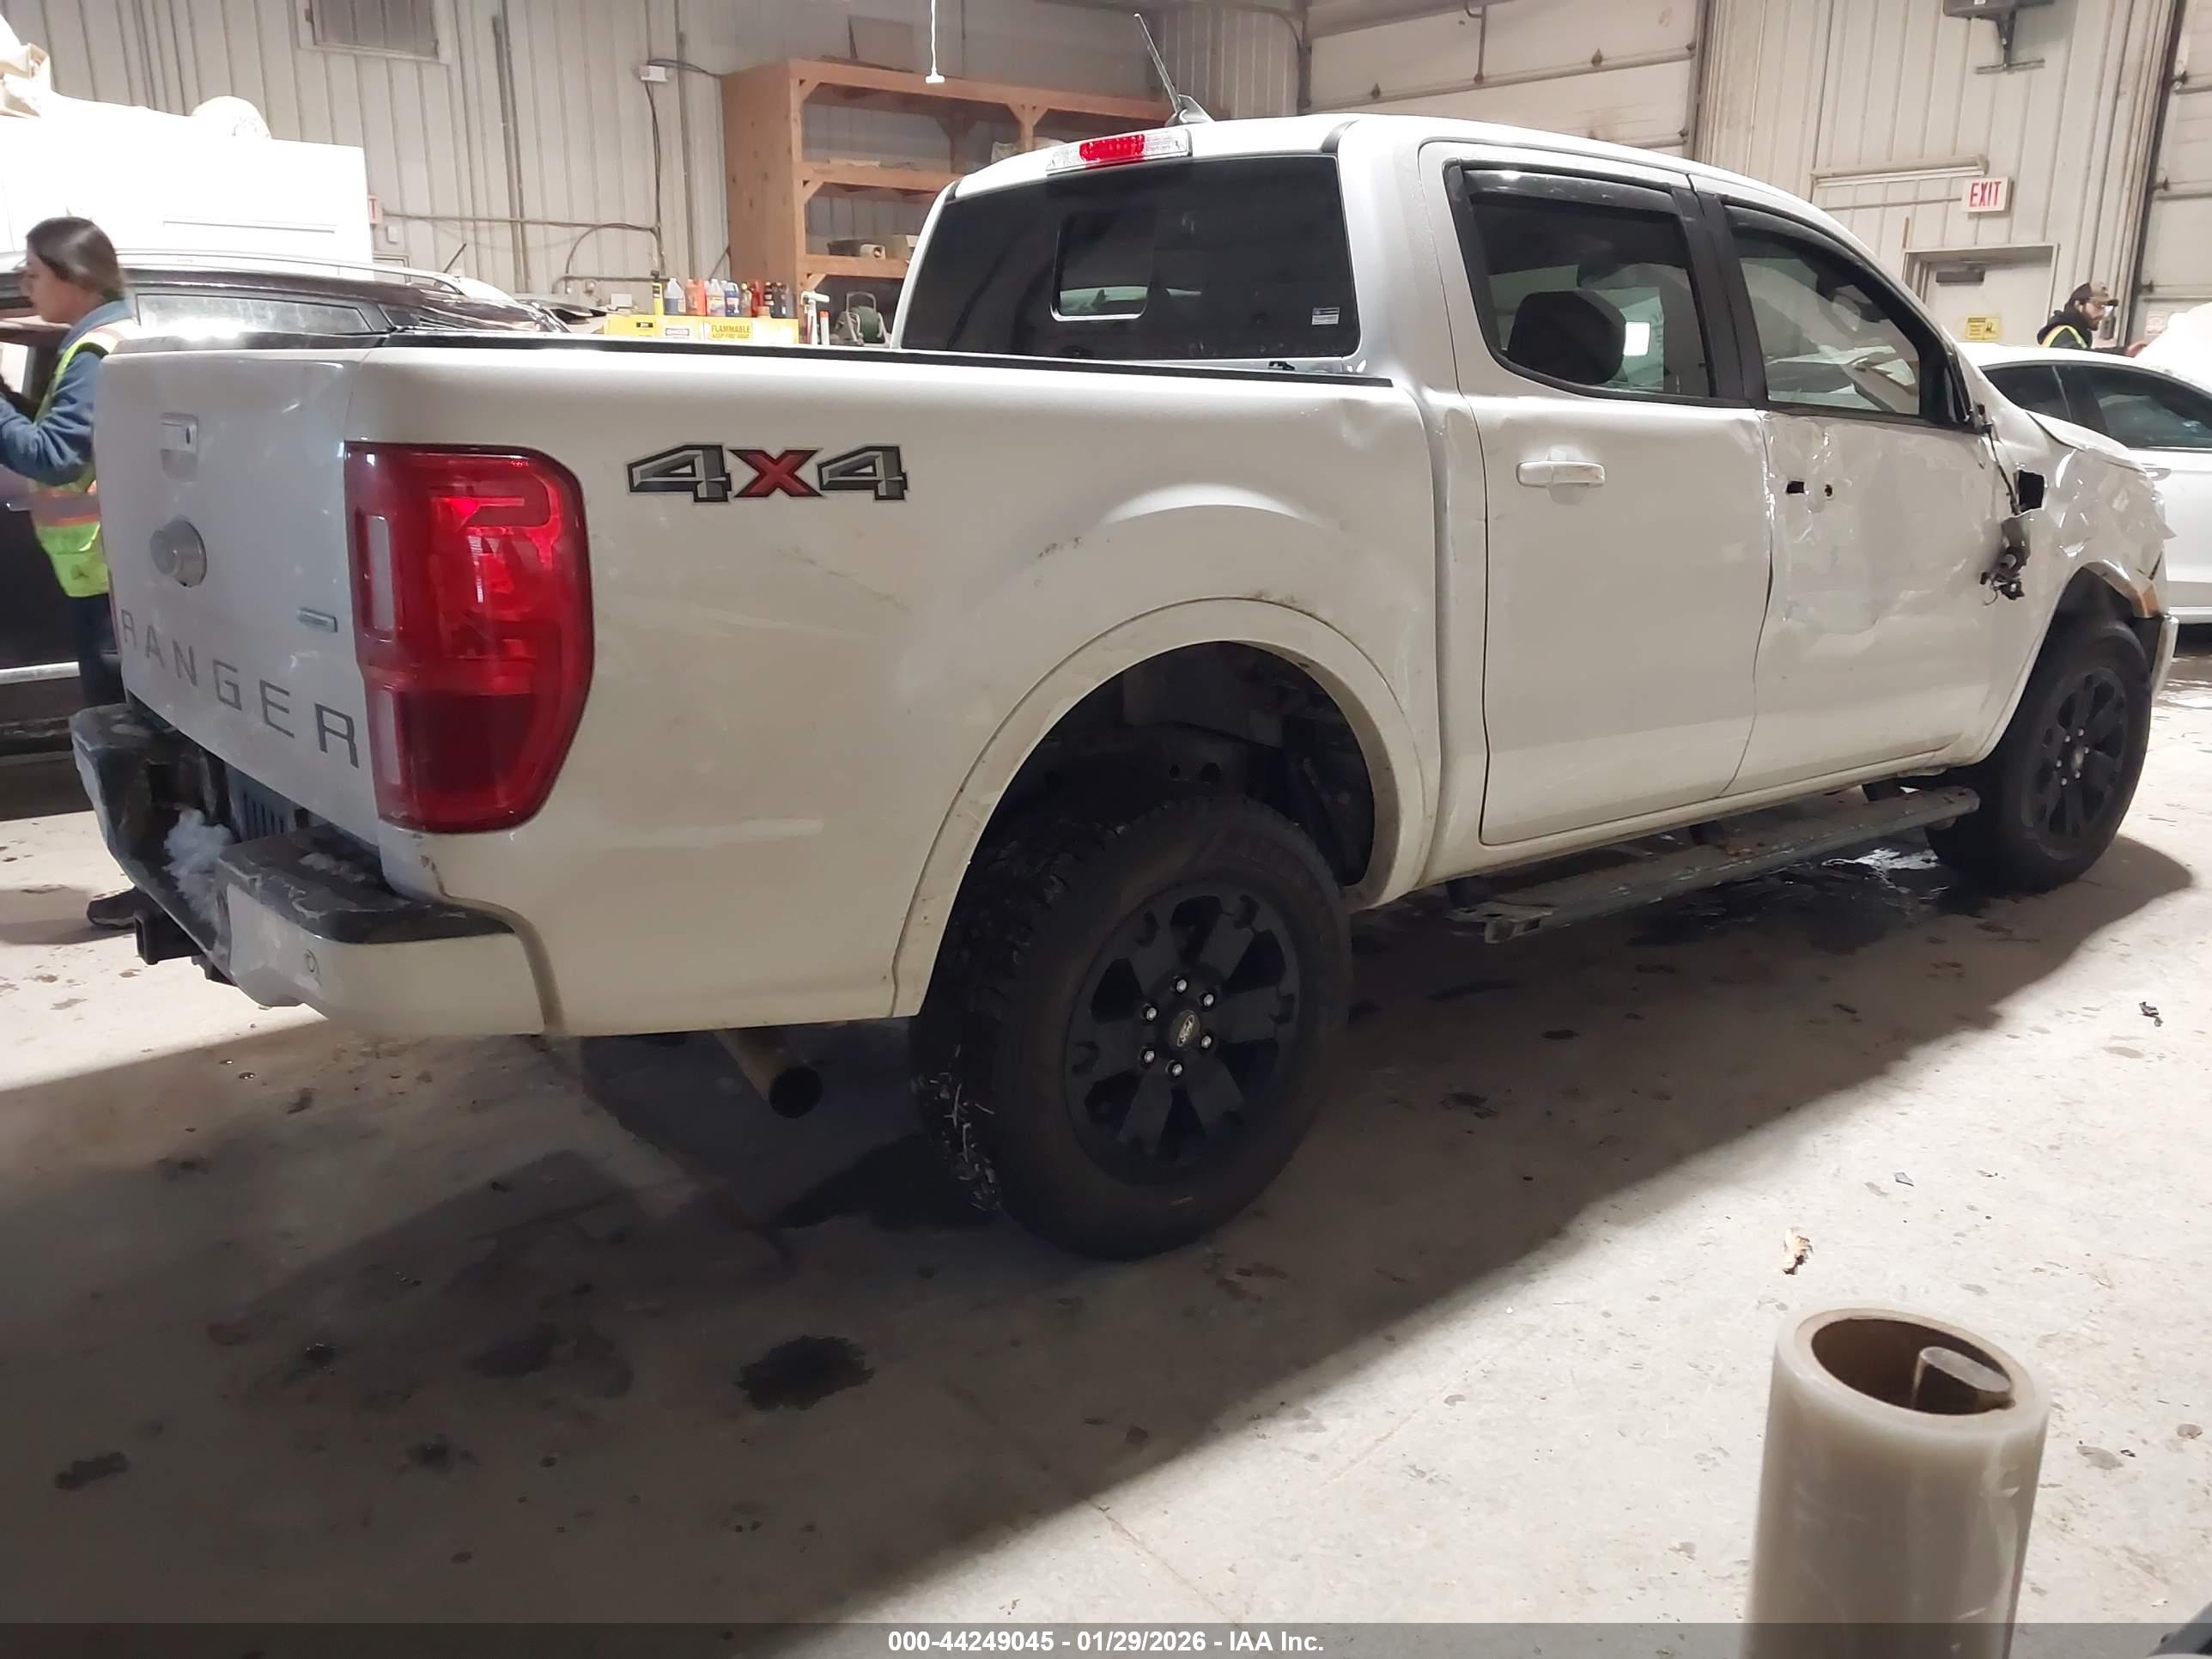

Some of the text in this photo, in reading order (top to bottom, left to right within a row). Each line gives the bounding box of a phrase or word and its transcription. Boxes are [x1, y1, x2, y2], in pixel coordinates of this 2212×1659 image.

[1969, 180, 2002, 207] EXIT
[711, 325, 750, 333] FLAMMABLE
[120, 608, 360, 769] RANGER
